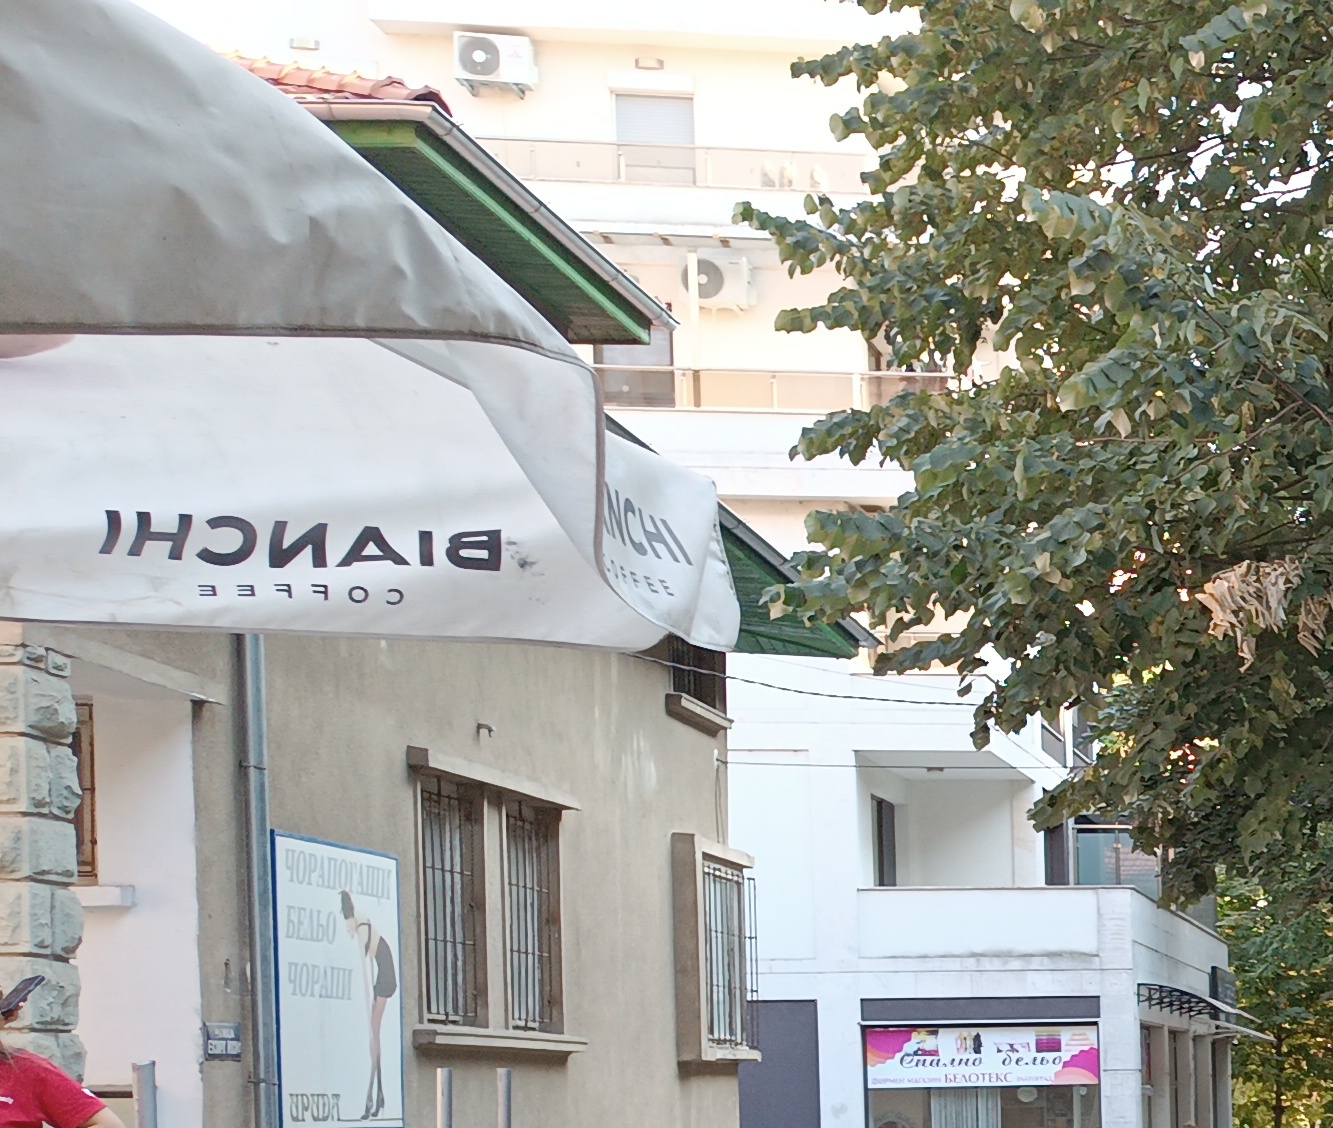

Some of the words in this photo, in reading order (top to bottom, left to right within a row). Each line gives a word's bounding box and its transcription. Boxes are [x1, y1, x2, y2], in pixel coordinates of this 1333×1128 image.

[603, 480, 693, 566] NCHI
[604, 559, 674, 597] OFFEE
[285, 905, 337, 945] БЕЛЬО
[899, 1052, 983, 1069] Спално
[1001, 1050, 1062, 1067] бельо
[944, 1072, 1013, 1084] БЕЛОТЕКС
